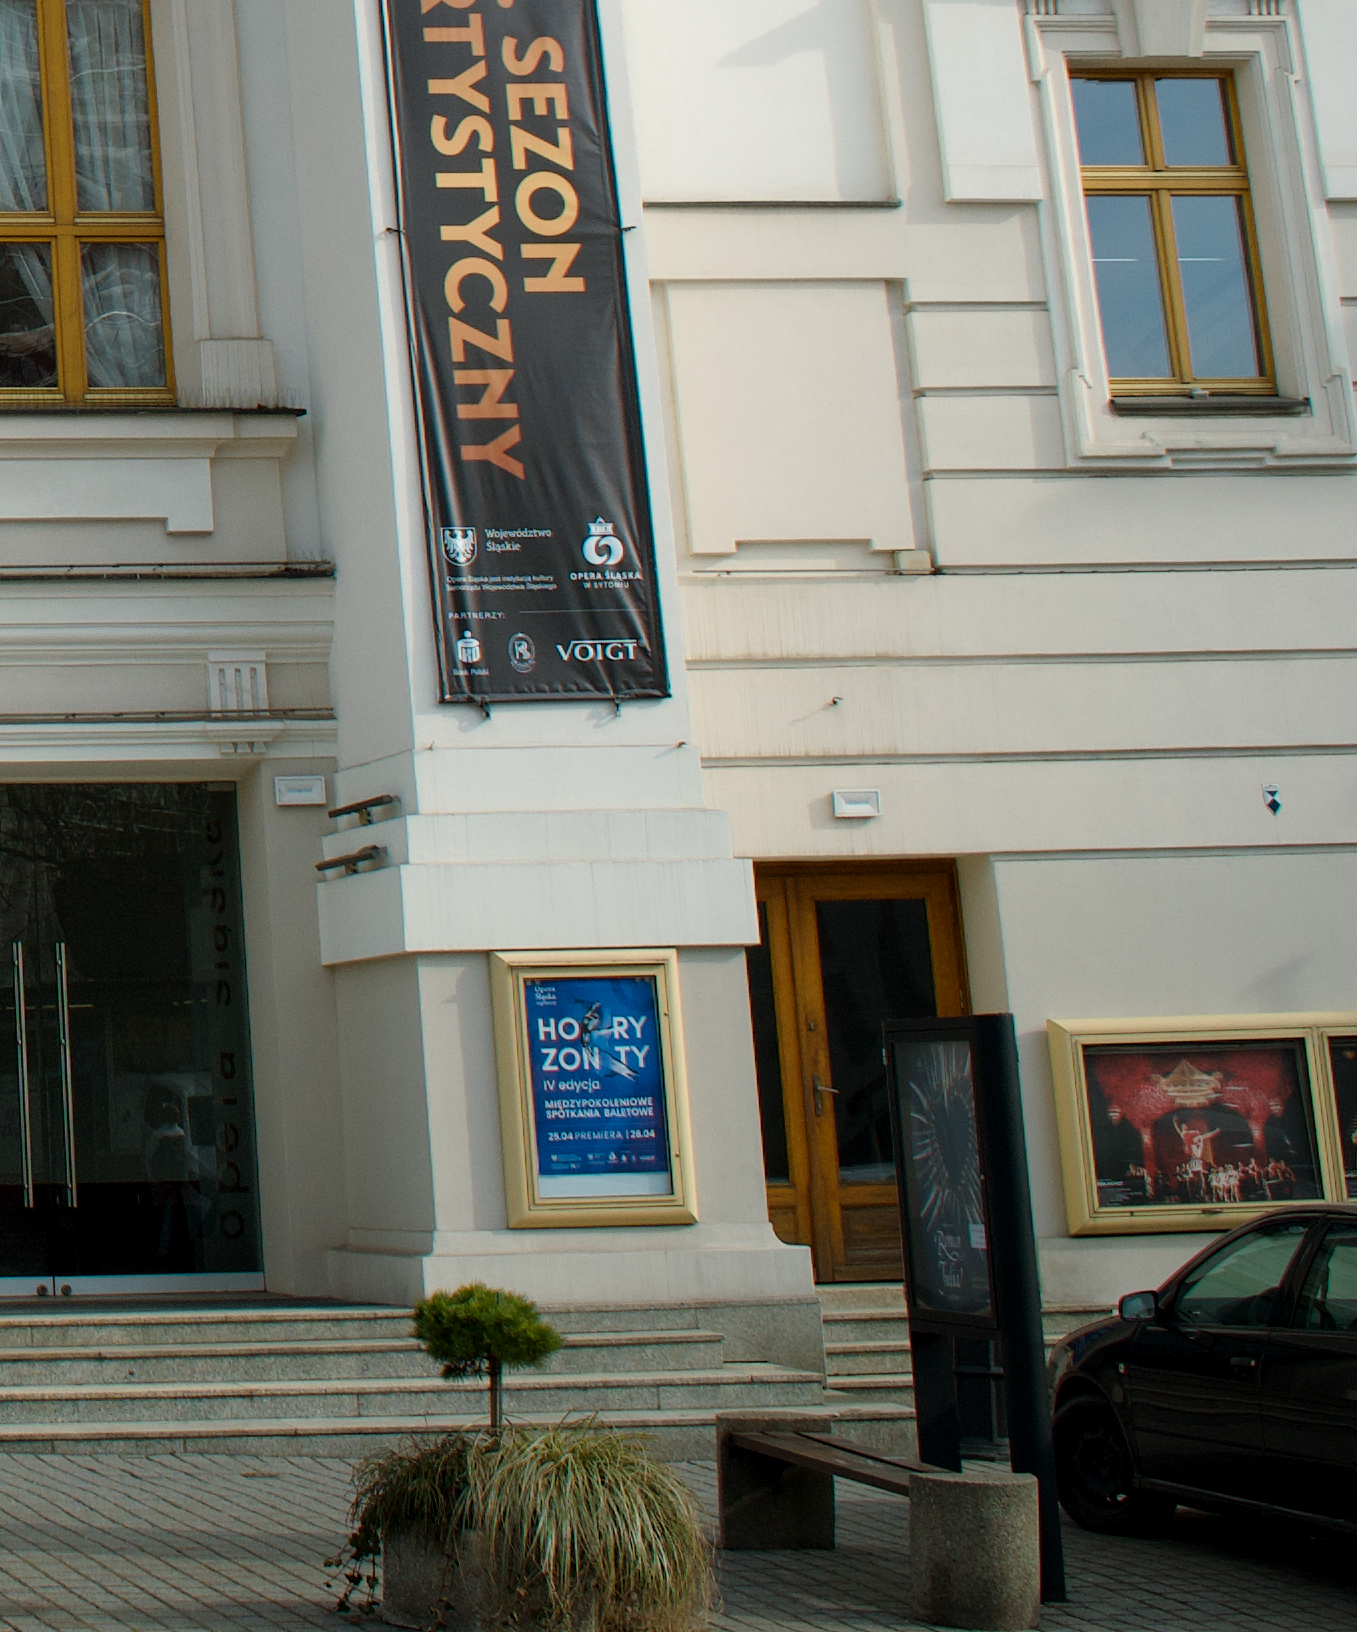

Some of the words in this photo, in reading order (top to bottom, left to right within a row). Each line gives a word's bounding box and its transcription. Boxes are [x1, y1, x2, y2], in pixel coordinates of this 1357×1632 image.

[500, 35, 586, 294] SEZON
[555, 639, 638, 662] VOIGT
[543, 1079, 556, 1091] IV
[558, 1077, 601, 1094] edycja
[544, 1096, 653, 1111] MIĘDZYPOKOLENIOWE
[545, 1108, 602, 1119] SPOTKANIA
[603, 1106, 654, 1118] BALETOWE
